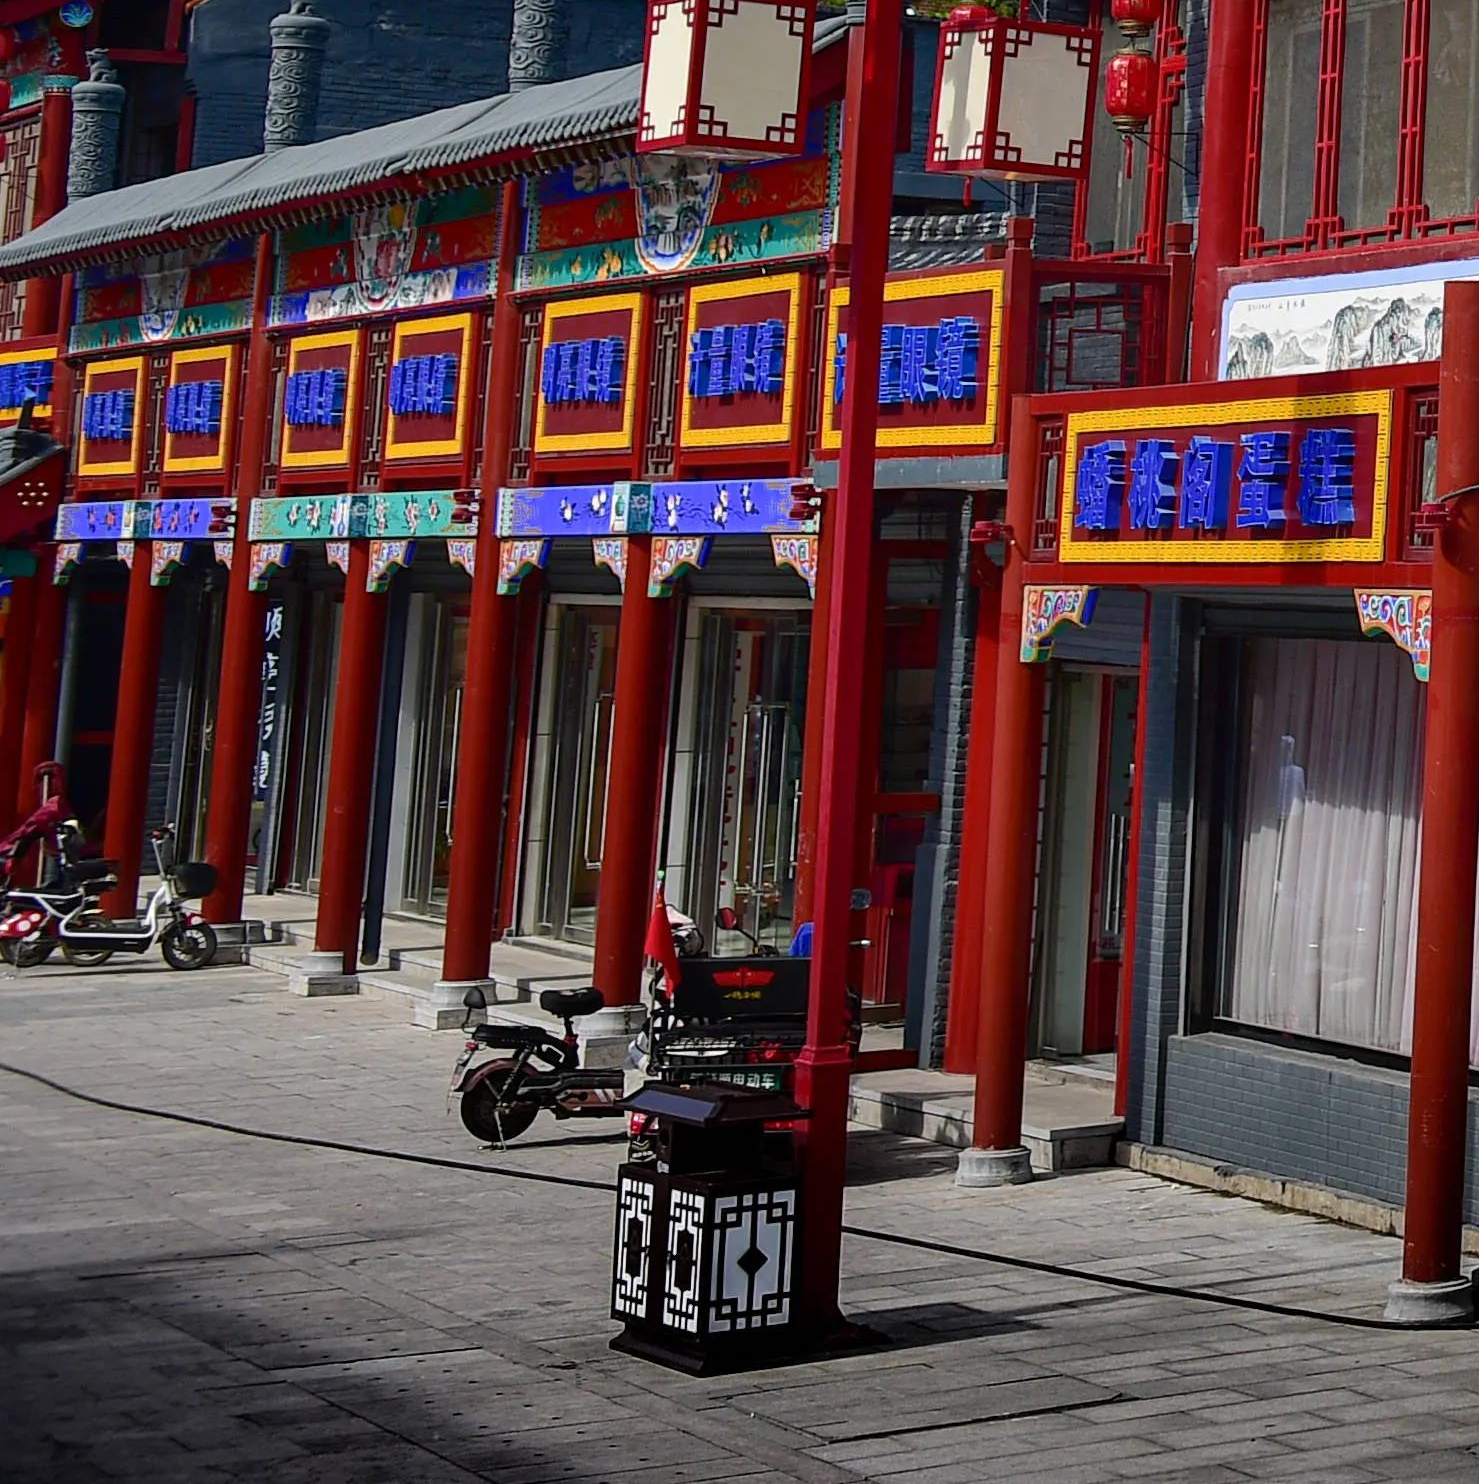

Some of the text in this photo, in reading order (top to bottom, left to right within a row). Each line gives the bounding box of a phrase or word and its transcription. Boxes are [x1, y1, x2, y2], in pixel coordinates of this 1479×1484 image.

[1074, 428, 1356, 530] 蟠桃阁蛋糕
